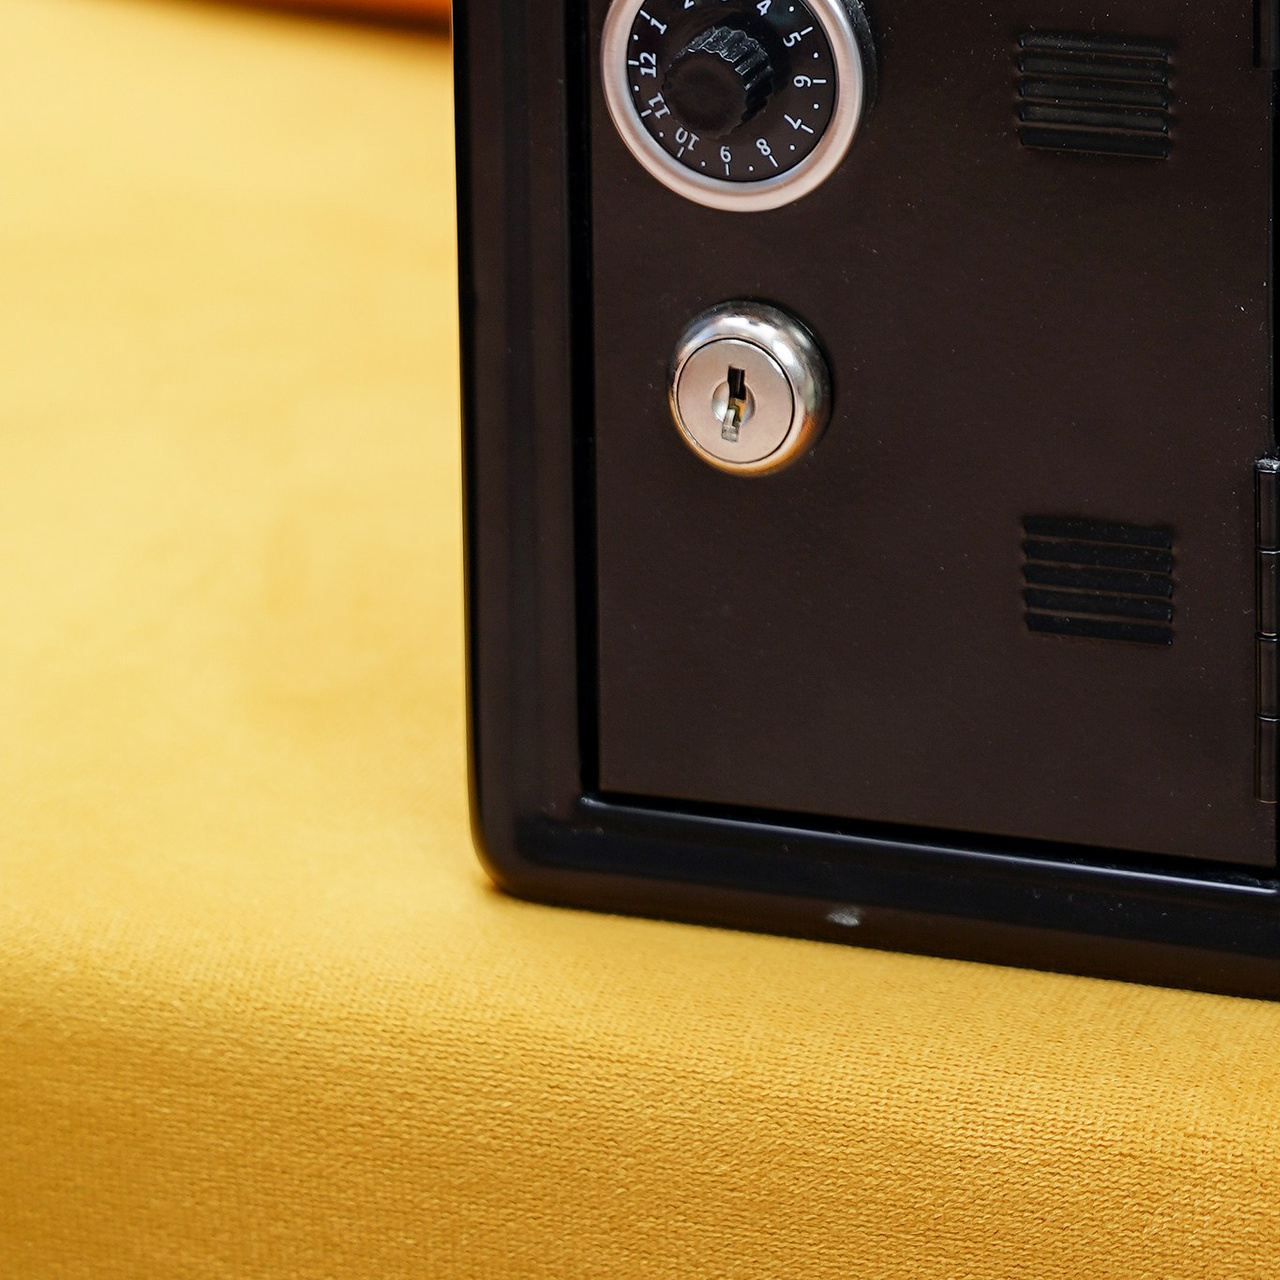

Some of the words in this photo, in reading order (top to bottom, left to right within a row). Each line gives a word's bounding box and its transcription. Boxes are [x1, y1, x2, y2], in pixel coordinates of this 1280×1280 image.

[650, 18, 667, 35] 1
[783, 32, 801, 47] 5
[640, 52, 657, 77] 12
[793, 75, 811, 87] 6
[648, 92, 671, 119] 11
[784, 114, 802, 129] 7
[675, 127, 700, 151] 10
[756, 139, 771, 156] 8
[720, 146, 731, 162] 9
